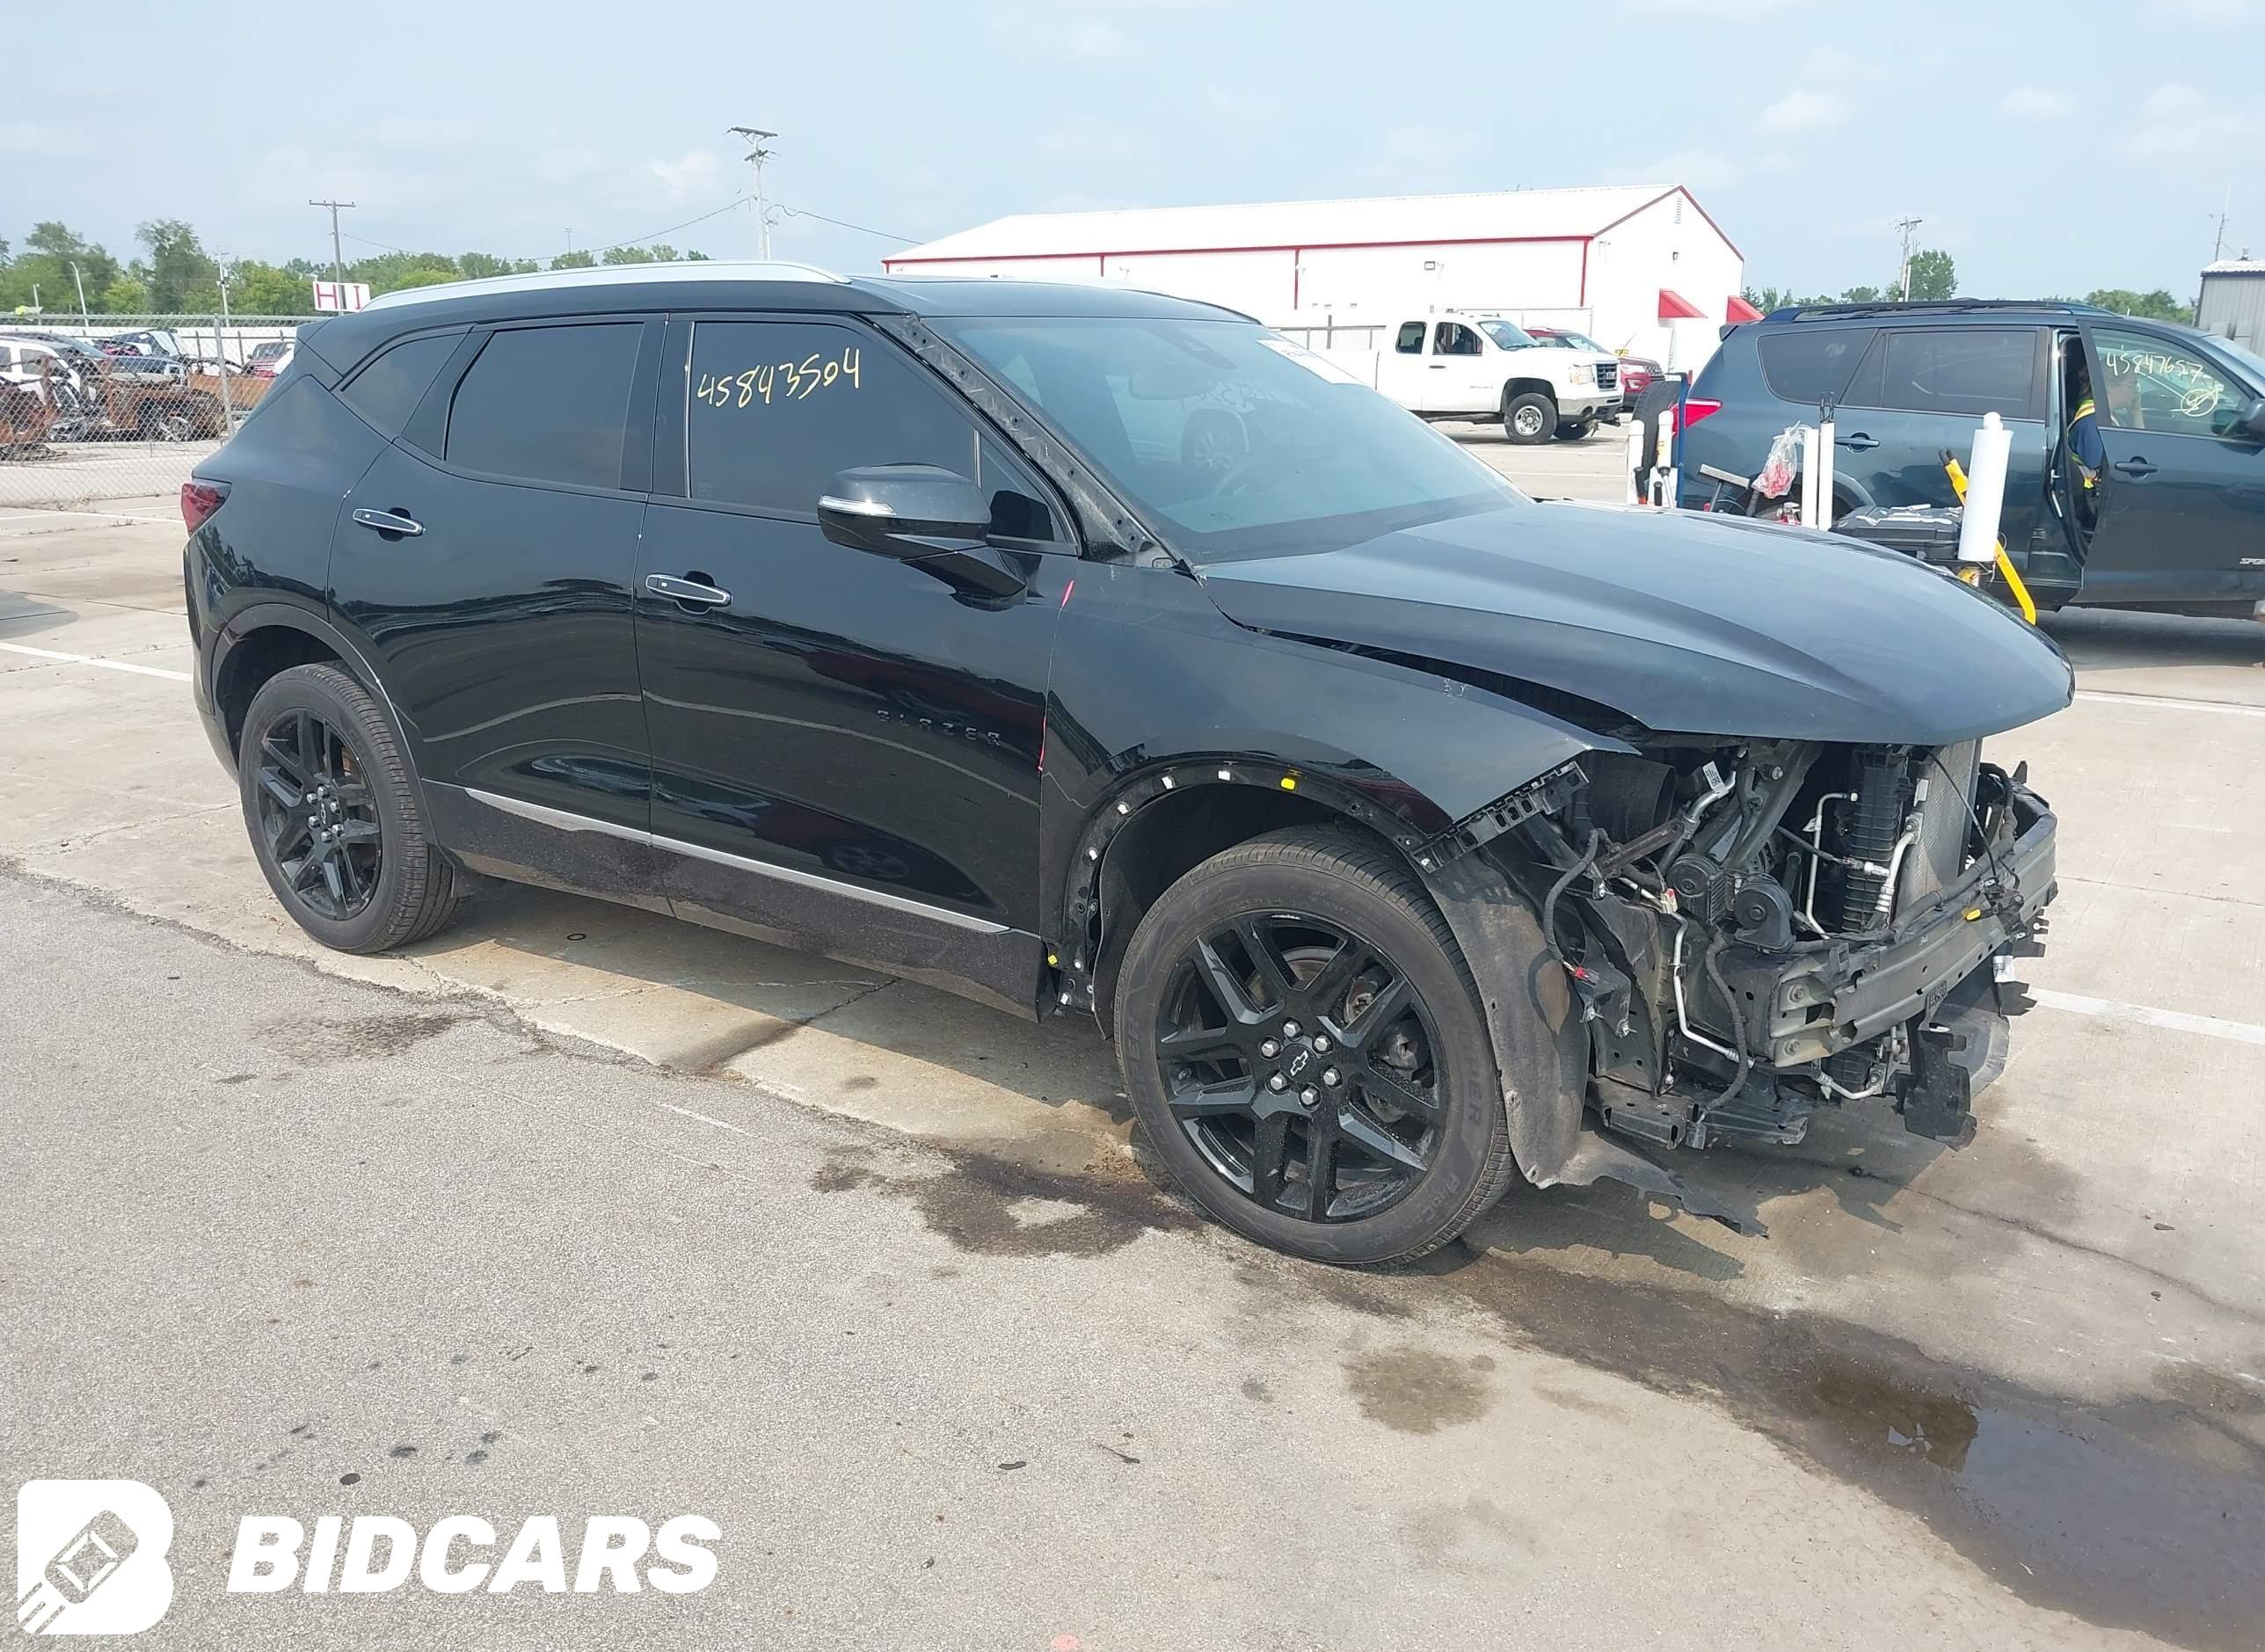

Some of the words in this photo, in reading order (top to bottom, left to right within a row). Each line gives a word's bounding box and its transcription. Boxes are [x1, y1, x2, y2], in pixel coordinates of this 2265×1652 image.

[696, 346, 861, 409] 45843504
[877, 710, 1001, 747] BLAZER
[1127, 1015, 1170, 1147] COOPER
